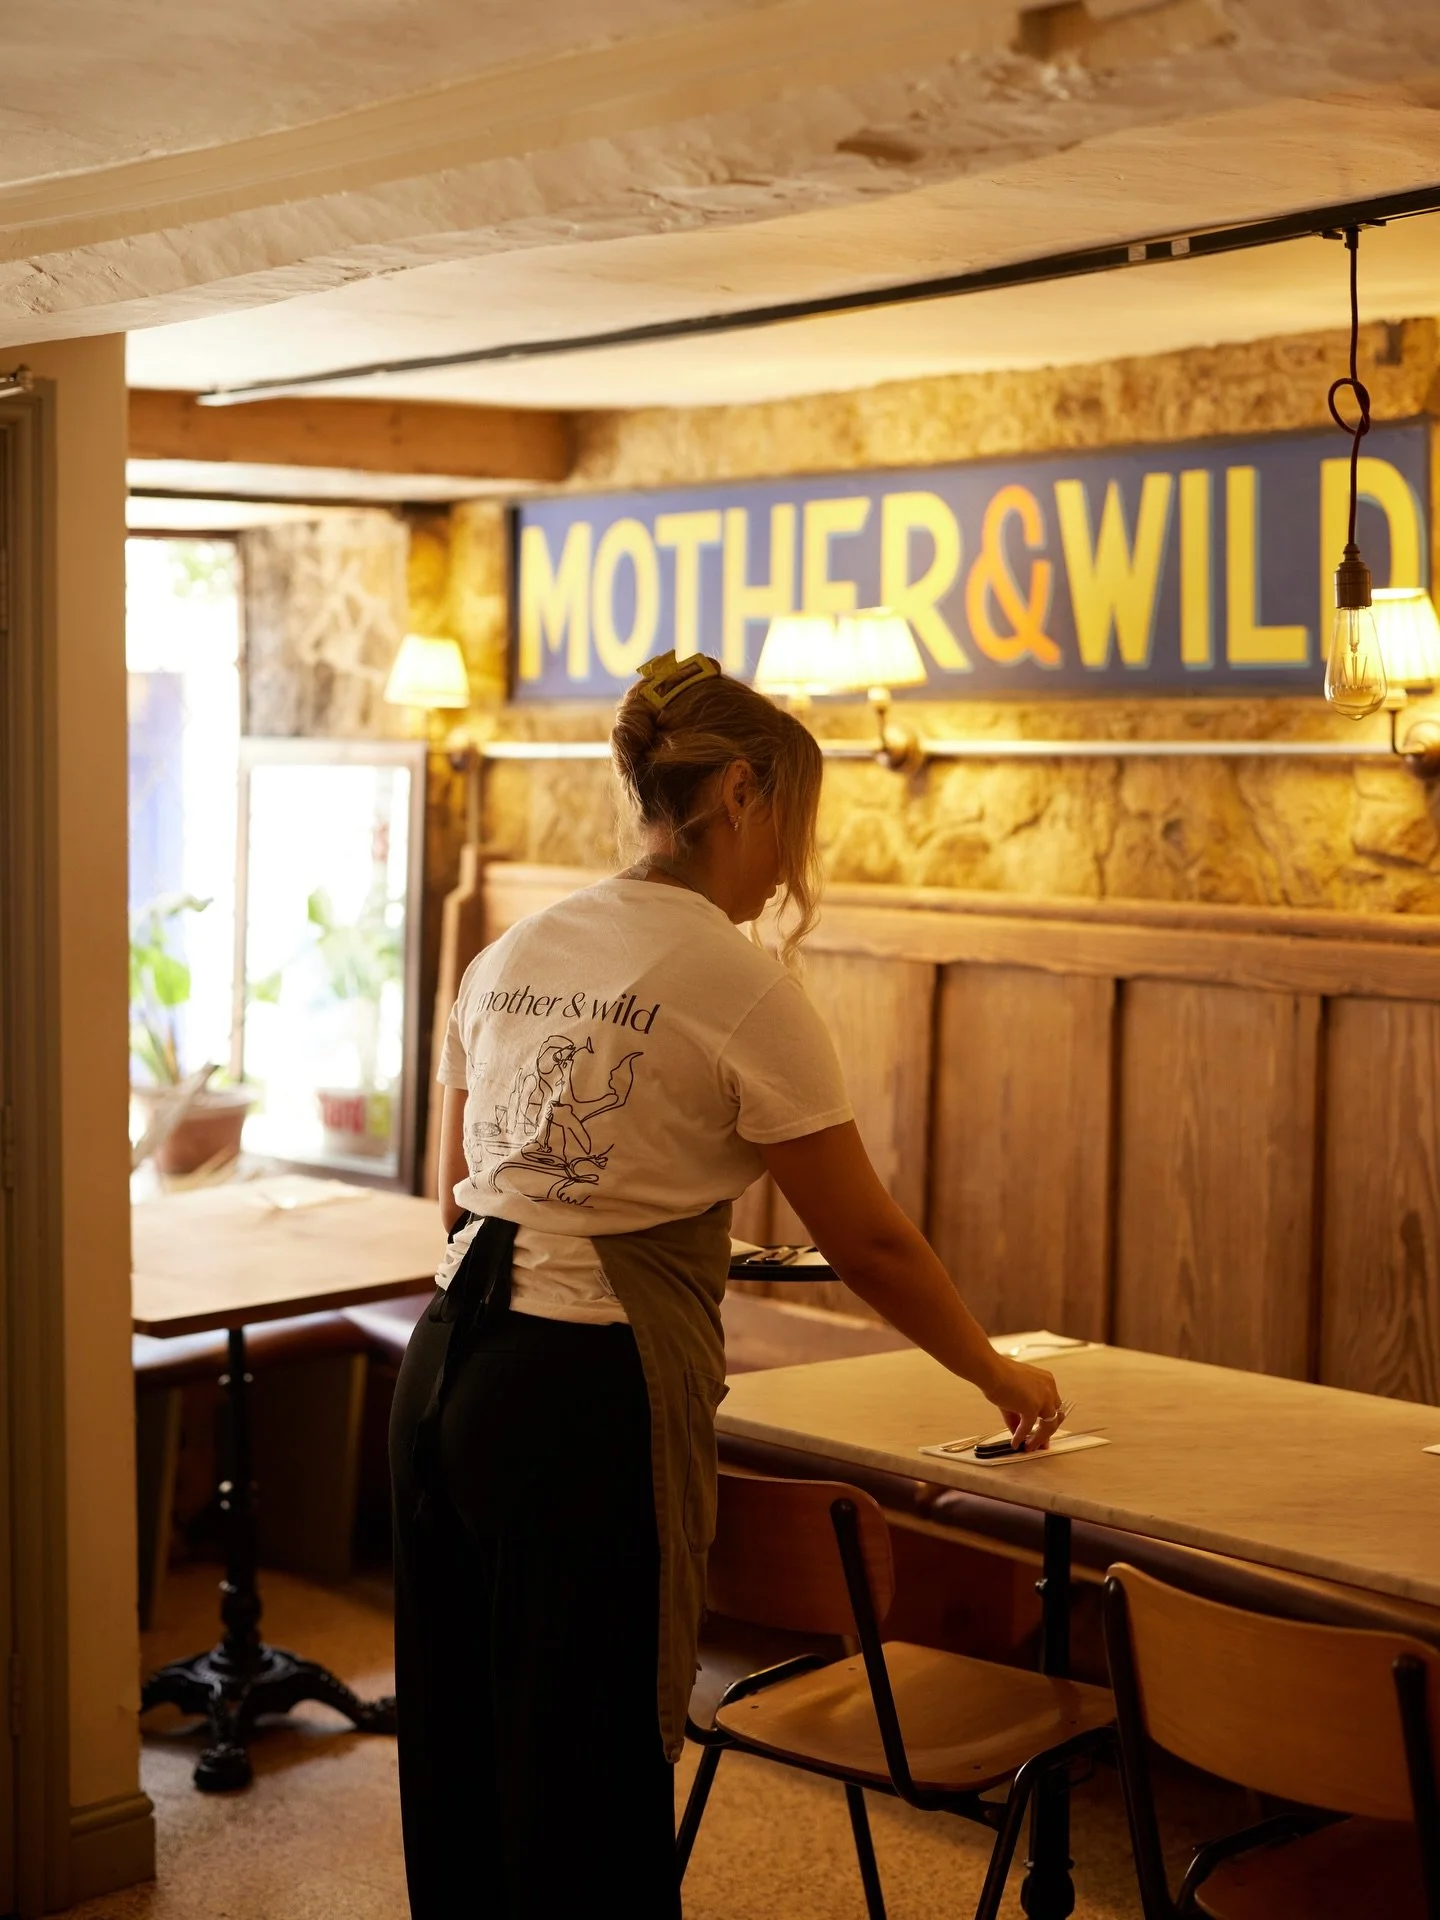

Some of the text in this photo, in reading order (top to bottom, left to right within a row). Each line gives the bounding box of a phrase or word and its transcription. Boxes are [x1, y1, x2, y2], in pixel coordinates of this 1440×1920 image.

[478, 985, 660, 1034] mother & wild
